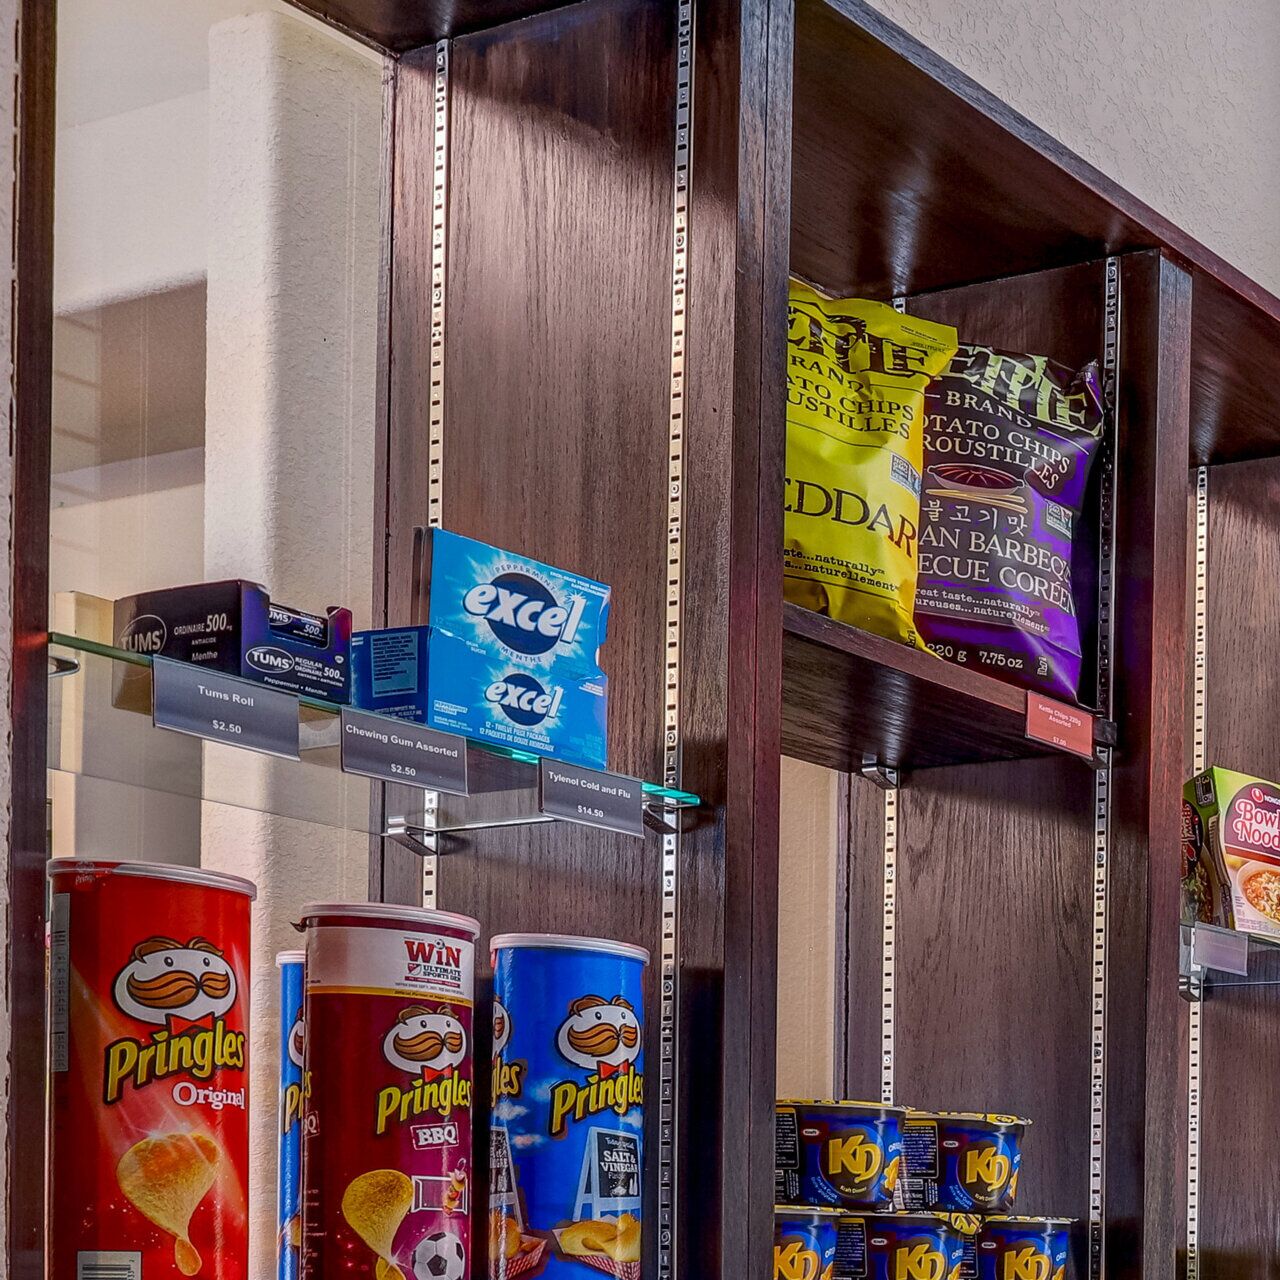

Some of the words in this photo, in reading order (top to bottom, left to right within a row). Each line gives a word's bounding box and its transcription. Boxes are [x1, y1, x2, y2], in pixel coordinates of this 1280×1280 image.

[839, 396, 914, 423] CHIPS
[945, 390, 1032, 429] BRAND
[1007, 431, 1071, 474] CHIPS
[464, 583, 588, 645] excel
[253, 651, 290, 668] TUMS
[198, 685, 229, 700] Tums
[233, 694, 254, 707] Roll
[486, 681, 564, 718] excel
[212, 720, 242, 734] $2.50
[345, 724, 387, 744] Chewing
[391, 735, 412, 749] Gum
[416, 740, 458, 758] Assorted
[391, 763, 416, 777] $2.50
[548, 770, 579, 787] Tylenol
[581, 778, 599, 793] Cold
[601, 784, 616, 796] and
[618, 787, 631, 799] Flu
[577, 804, 604, 818] $14.50
[423, 965, 462, 977] ULTIMATE
[103, 1024, 246, 1105] Pringles
[172, 1081, 245, 1110] Original
[376, 1071, 471, 1135] Pringles
[551, 1066, 644, 1134] Pringles
[416, 1125, 457, 1146] BBQ
